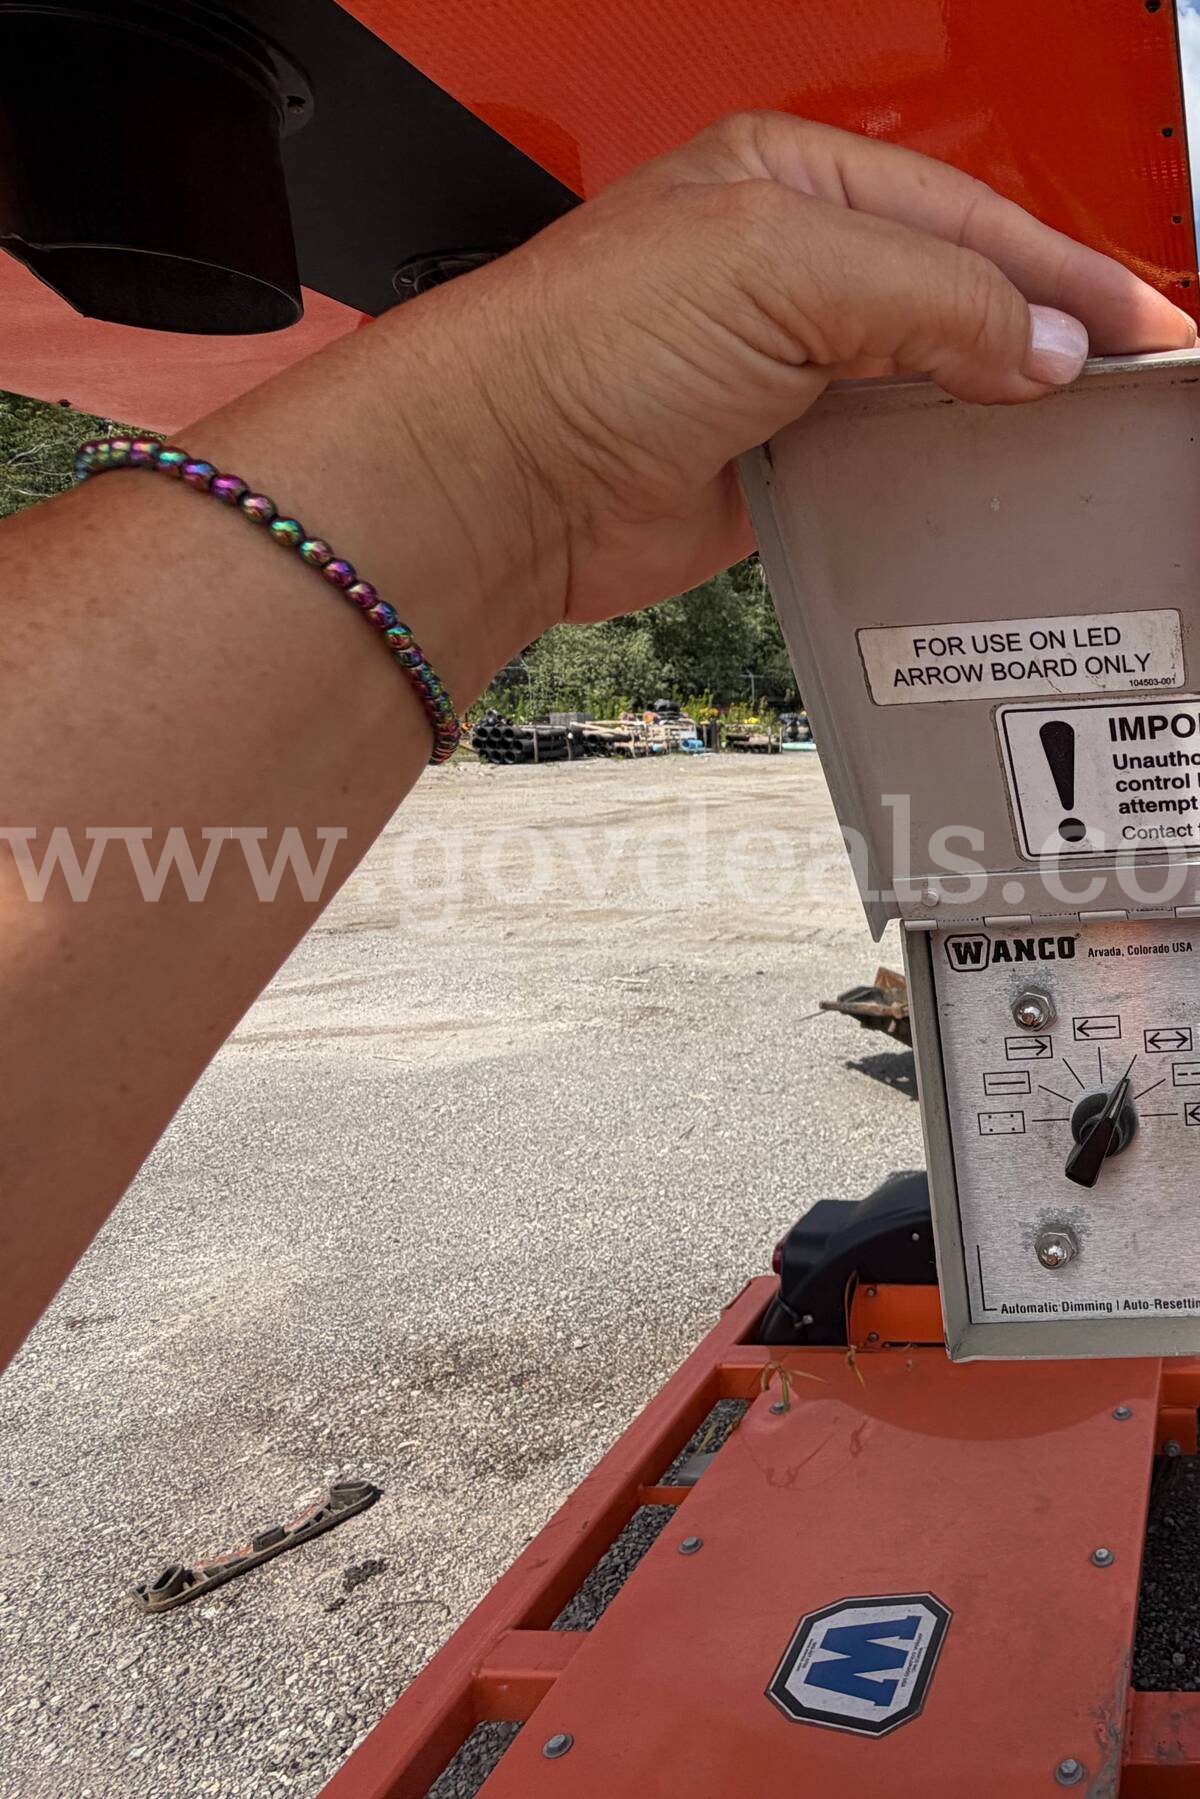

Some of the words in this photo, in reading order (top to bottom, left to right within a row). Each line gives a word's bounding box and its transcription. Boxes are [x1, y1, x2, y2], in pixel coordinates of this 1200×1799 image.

[913, 636, 964, 657] FOR
[972, 633, 1022, 654] USE
[1029, 630, 1067, 650] ON
[1074, 627, 1121, 648] LED
[893, 663, 983, 687] ARROW
[991, 658, 1077, 681] BOARD
[1085, 653, 1151, 674] ONLY
[1129, 677, 1176, 687] 104503-001
[1115, 773, 1190, 793] control
[1118, 795, 1197, 815] attempt
[1122, 824, 1192, 841] Contact
[945, 934, 1078, 969] WANCO
[1088, 946, 1125, 959] Arvada,
[1127, 943, 1170, 956] Colorado
[1172, 941, 1193, 953] USA
[1000, 1302, 1058, 1314] Automatic
[1061, 1301, 1113, 1313] Dimming
[803, 1615, 923, 1708] W
